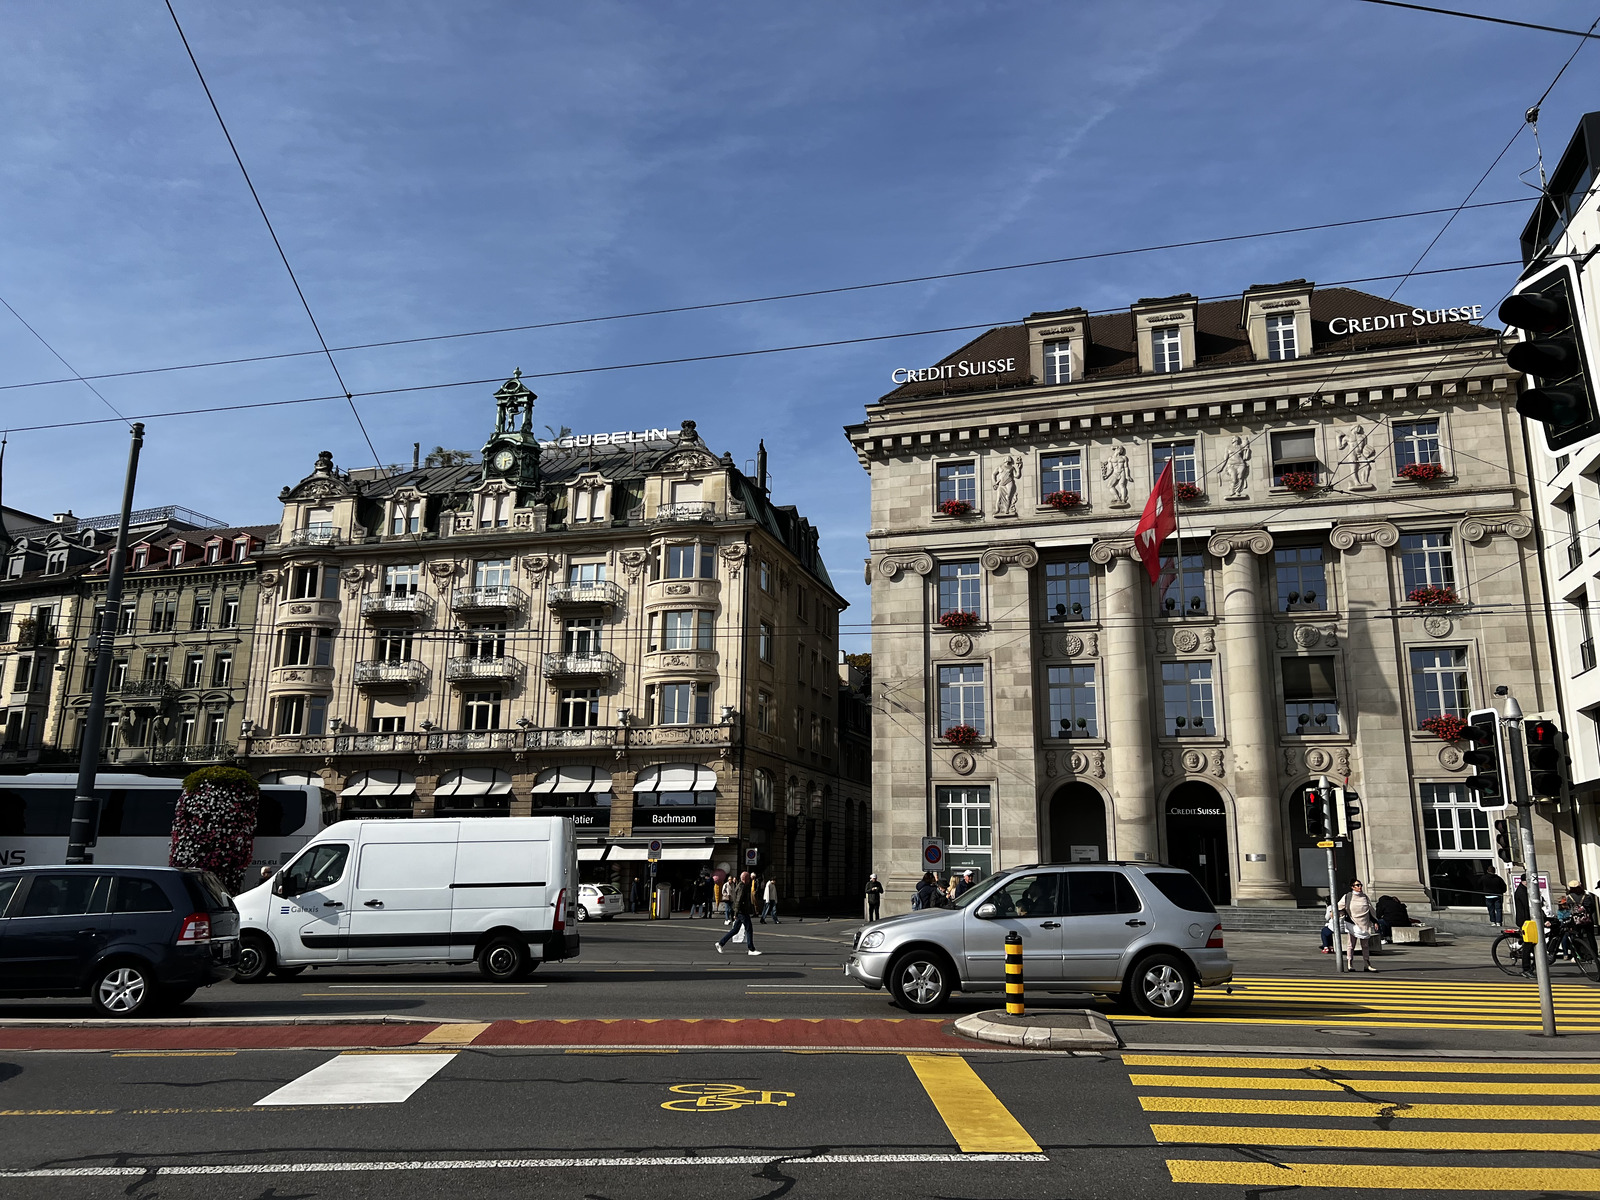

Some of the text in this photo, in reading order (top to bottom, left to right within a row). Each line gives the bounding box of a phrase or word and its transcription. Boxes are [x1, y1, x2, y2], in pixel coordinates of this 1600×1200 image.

[1328, 304, 1484, 335] CREDIT SUISSE
[891, 357, 1016, 384] CREDIT SUISSE
[1170, 807, 1220, 815] CREDIT SUISSE
[652, 814, 697, 824] Bachmann
[290, 905, 319, 913] Galexis
